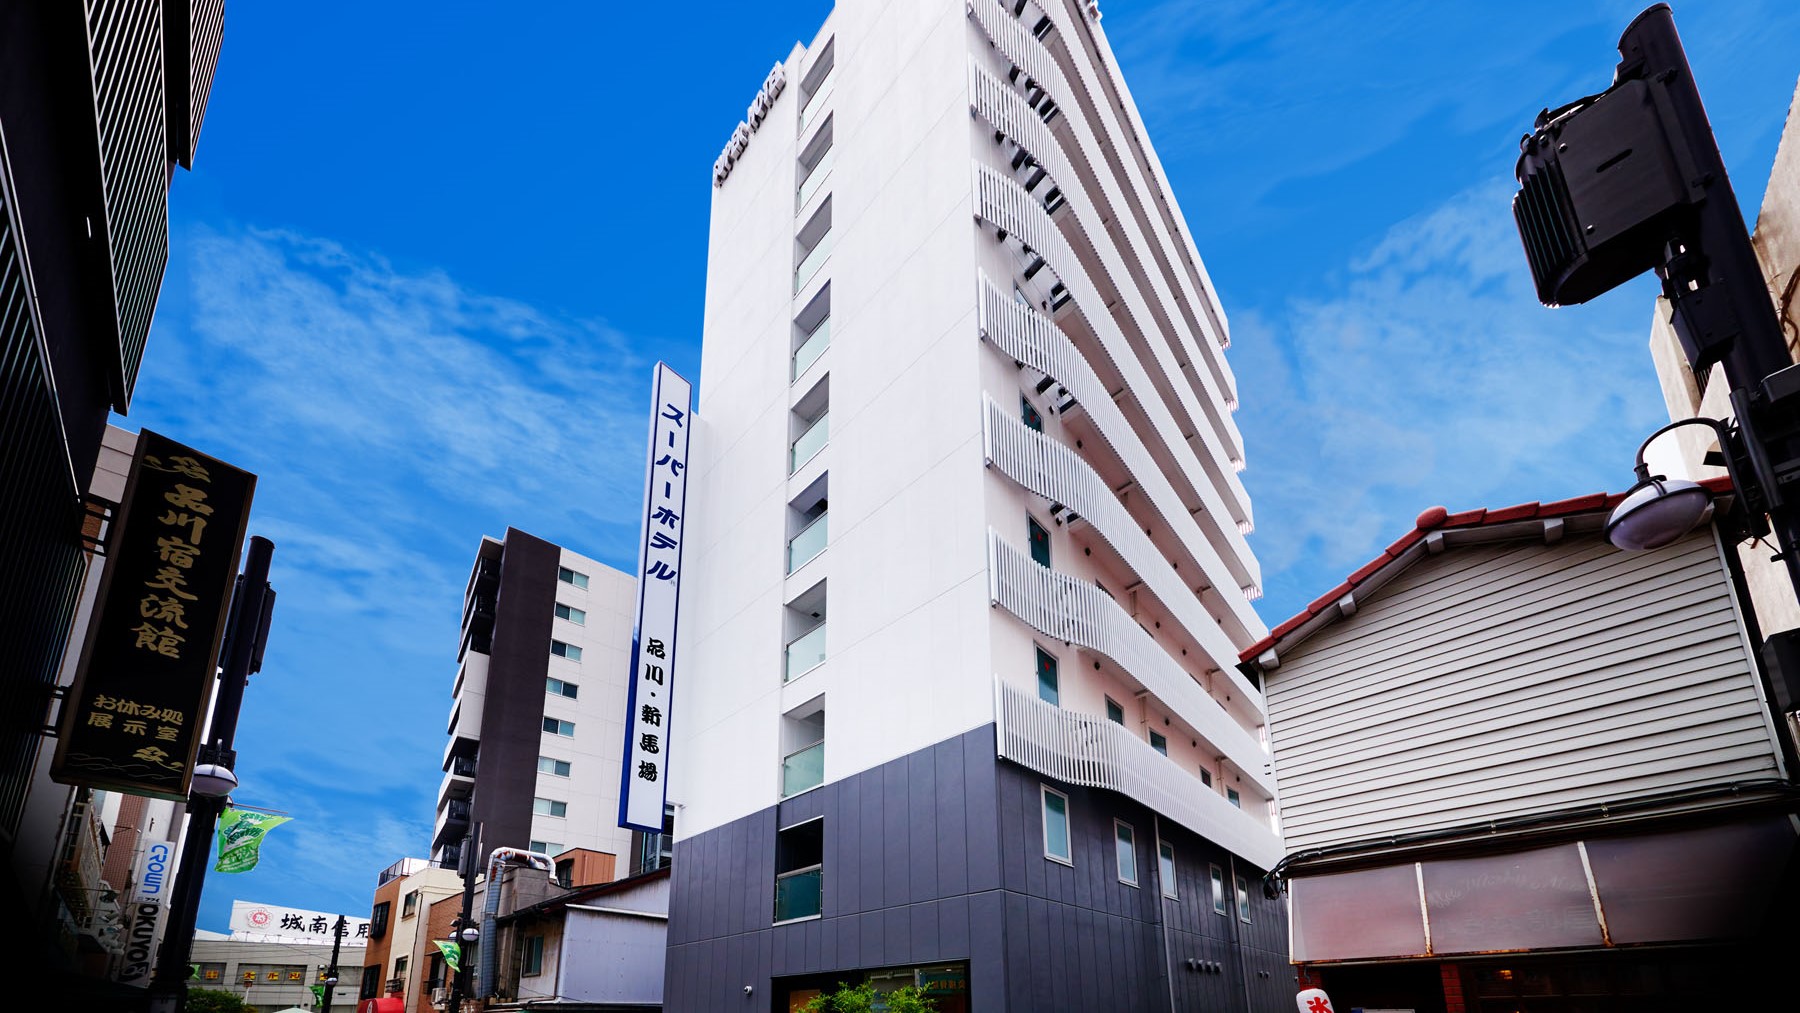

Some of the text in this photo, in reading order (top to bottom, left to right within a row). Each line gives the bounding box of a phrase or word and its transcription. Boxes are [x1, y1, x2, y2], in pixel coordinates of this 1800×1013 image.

[646, 403, 684, 581] スーパーホテル
[131, 483, 214, 659] 品川宿交流館
[88, 711, 179, 742] 展示室
[93, 694, 184, 726] お休み処
[638, 637, 666, 782] 品川・新馬場
